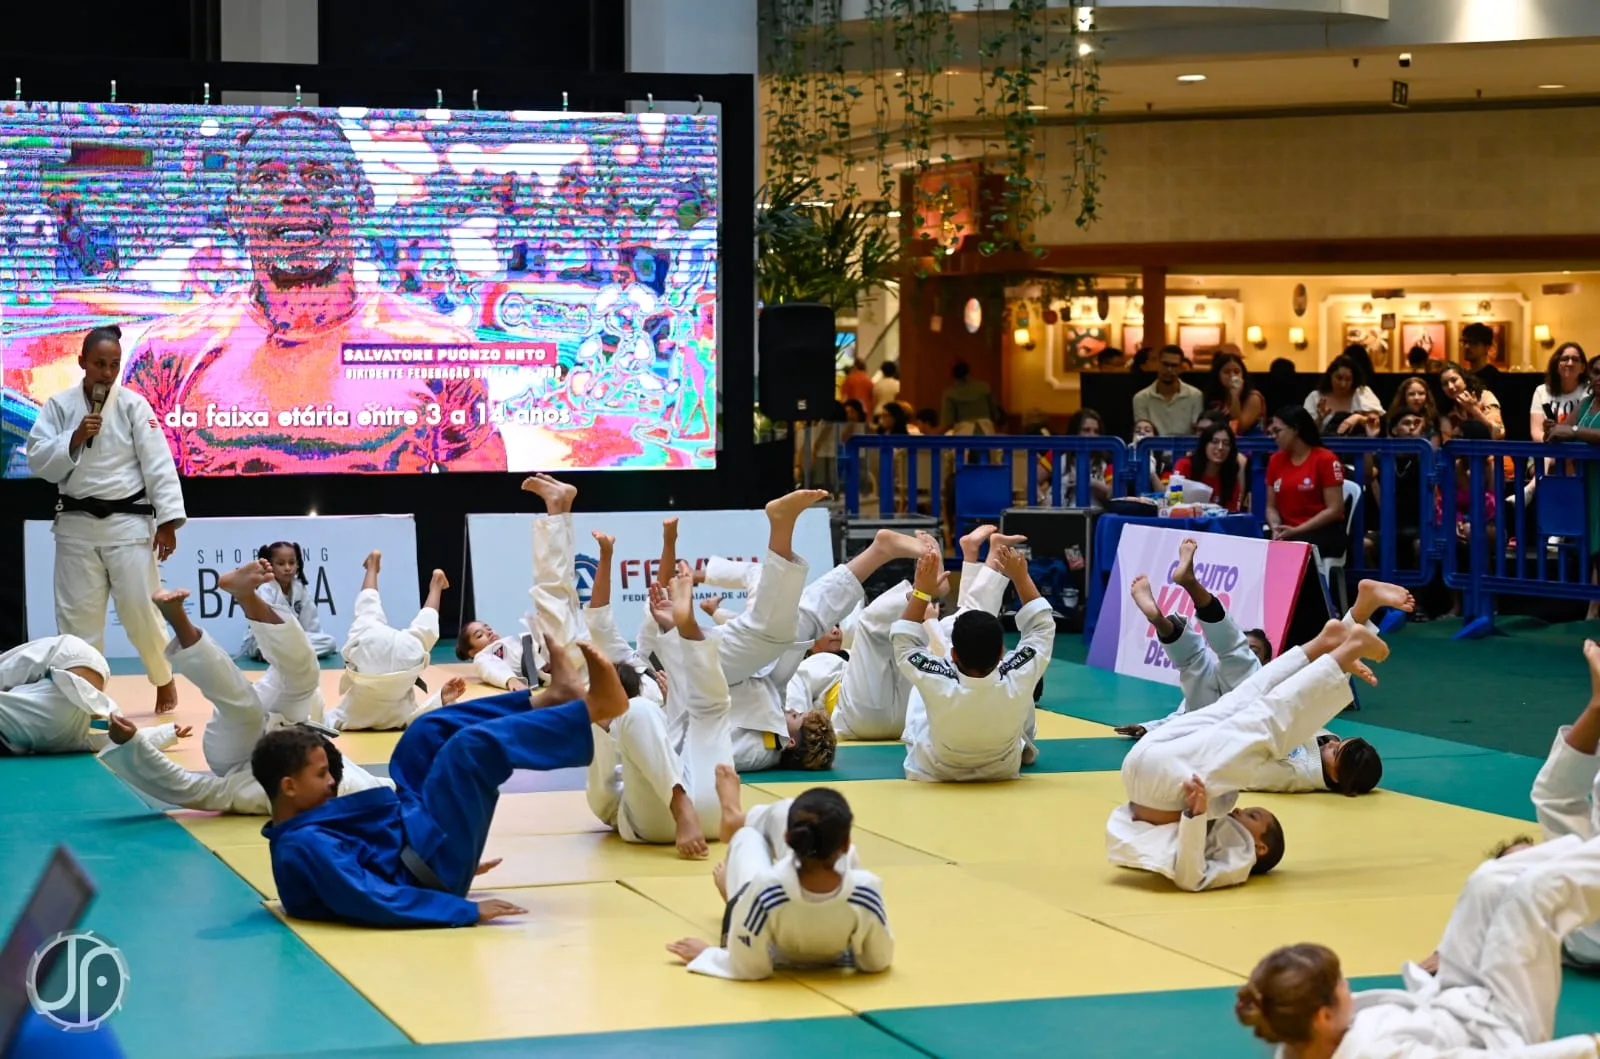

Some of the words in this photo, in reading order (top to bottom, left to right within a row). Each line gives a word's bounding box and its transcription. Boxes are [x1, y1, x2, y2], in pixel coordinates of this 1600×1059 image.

[343, 348, 433, 362] SALVATORE
[505, 348, 546, 361] NETO
[165, 403, 198, 428] da
[206, 403, 269, 427] faixa
[277, 402, 350, 427] etária
[357, 405, 418, 426] entre
[426, 403, 441, 426] 3
[450, 409, 466, 425] a
[514, 408, 571, 426] anos
[197, 547, 329, 564] SHOPNG
[721, 591, 734, 600] DE
